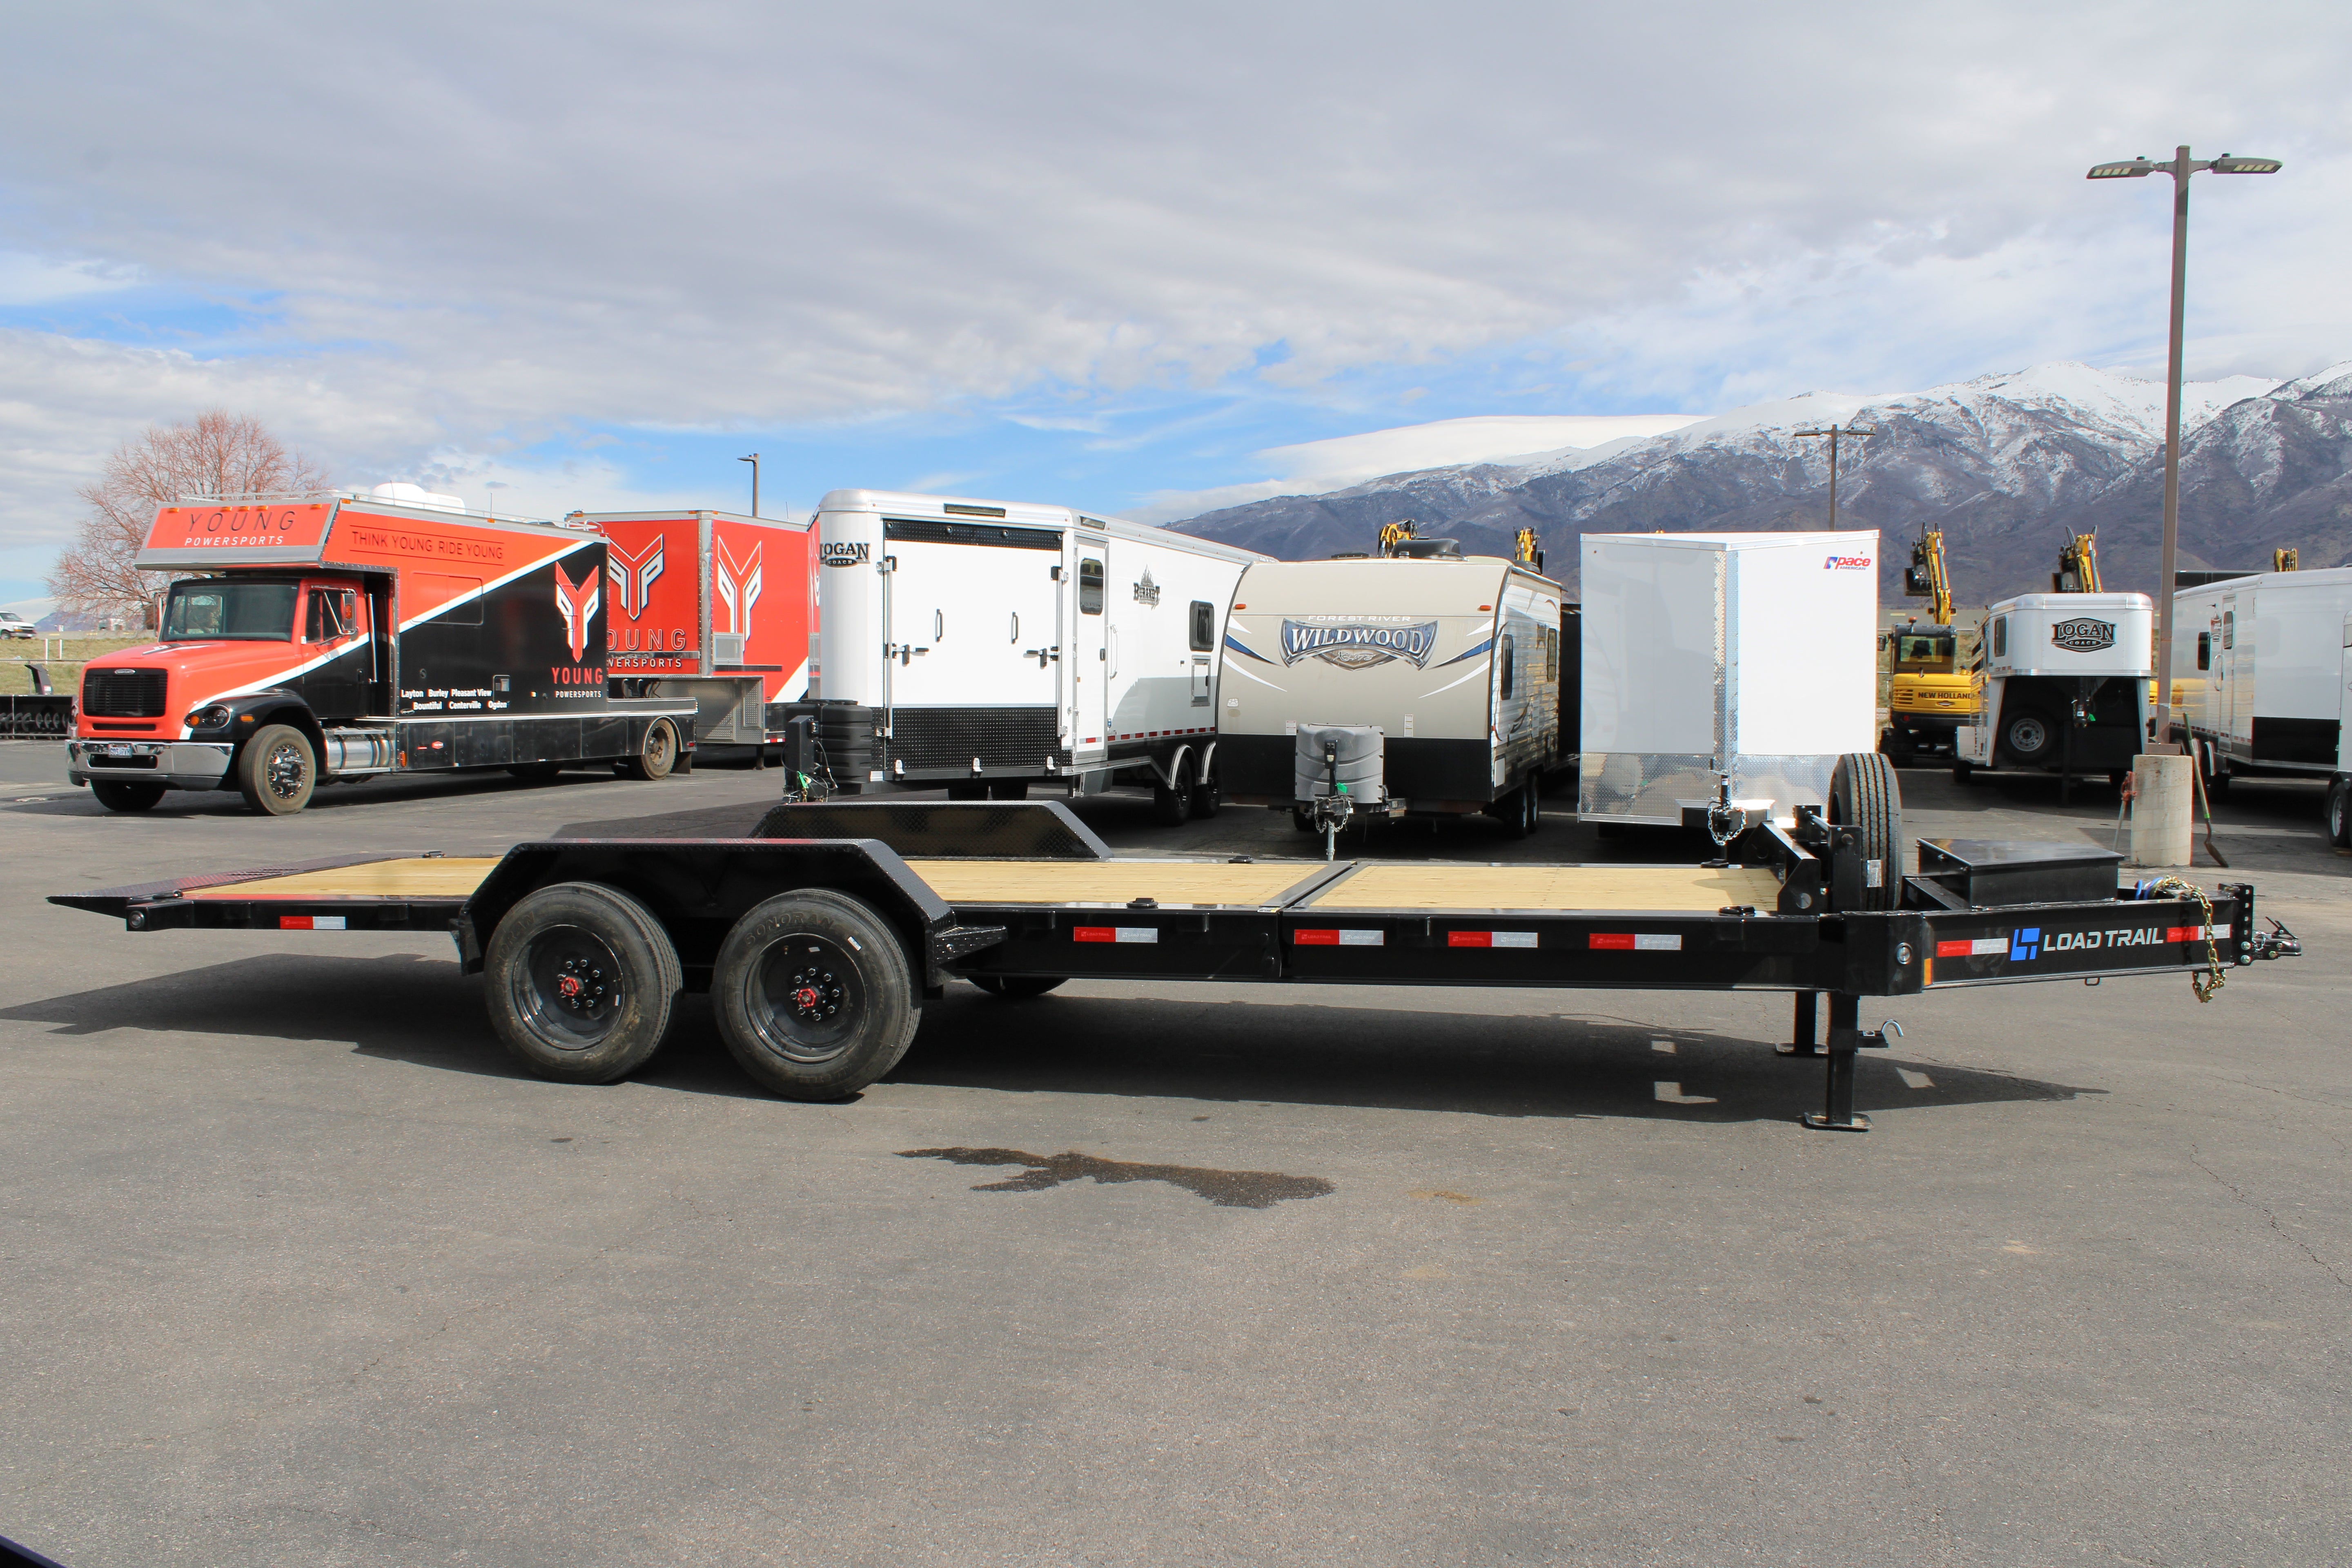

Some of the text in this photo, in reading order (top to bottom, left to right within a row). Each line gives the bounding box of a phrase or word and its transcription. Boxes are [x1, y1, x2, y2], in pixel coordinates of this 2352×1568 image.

[189, 511, 295, 532] YOUNG
[185, 536, 283, 546] POWERSPORTS
[352, 531, 503, 559] THINK YOUNG RIDE YOUNG
[1834, 557, 1871, 570] pace
[608, 629, 686, 650] OUNG
[1291, 628, 1425, 654] WILDWOOD
[2052, 624, 2116, 641] LOGAN
[551, 668, 604, 684] YOUNG
[401, 689, 424, 699] Layton
[428, 689, 449, 698] Burley
[450, 688, 477, 697] Pleasant
[413, 700, 508, 710] Bountiful Centerville Ogden
[745, 912, 834, 946] SONORAN
[2043, 928, 2164, 951] LOAD TRAIL
